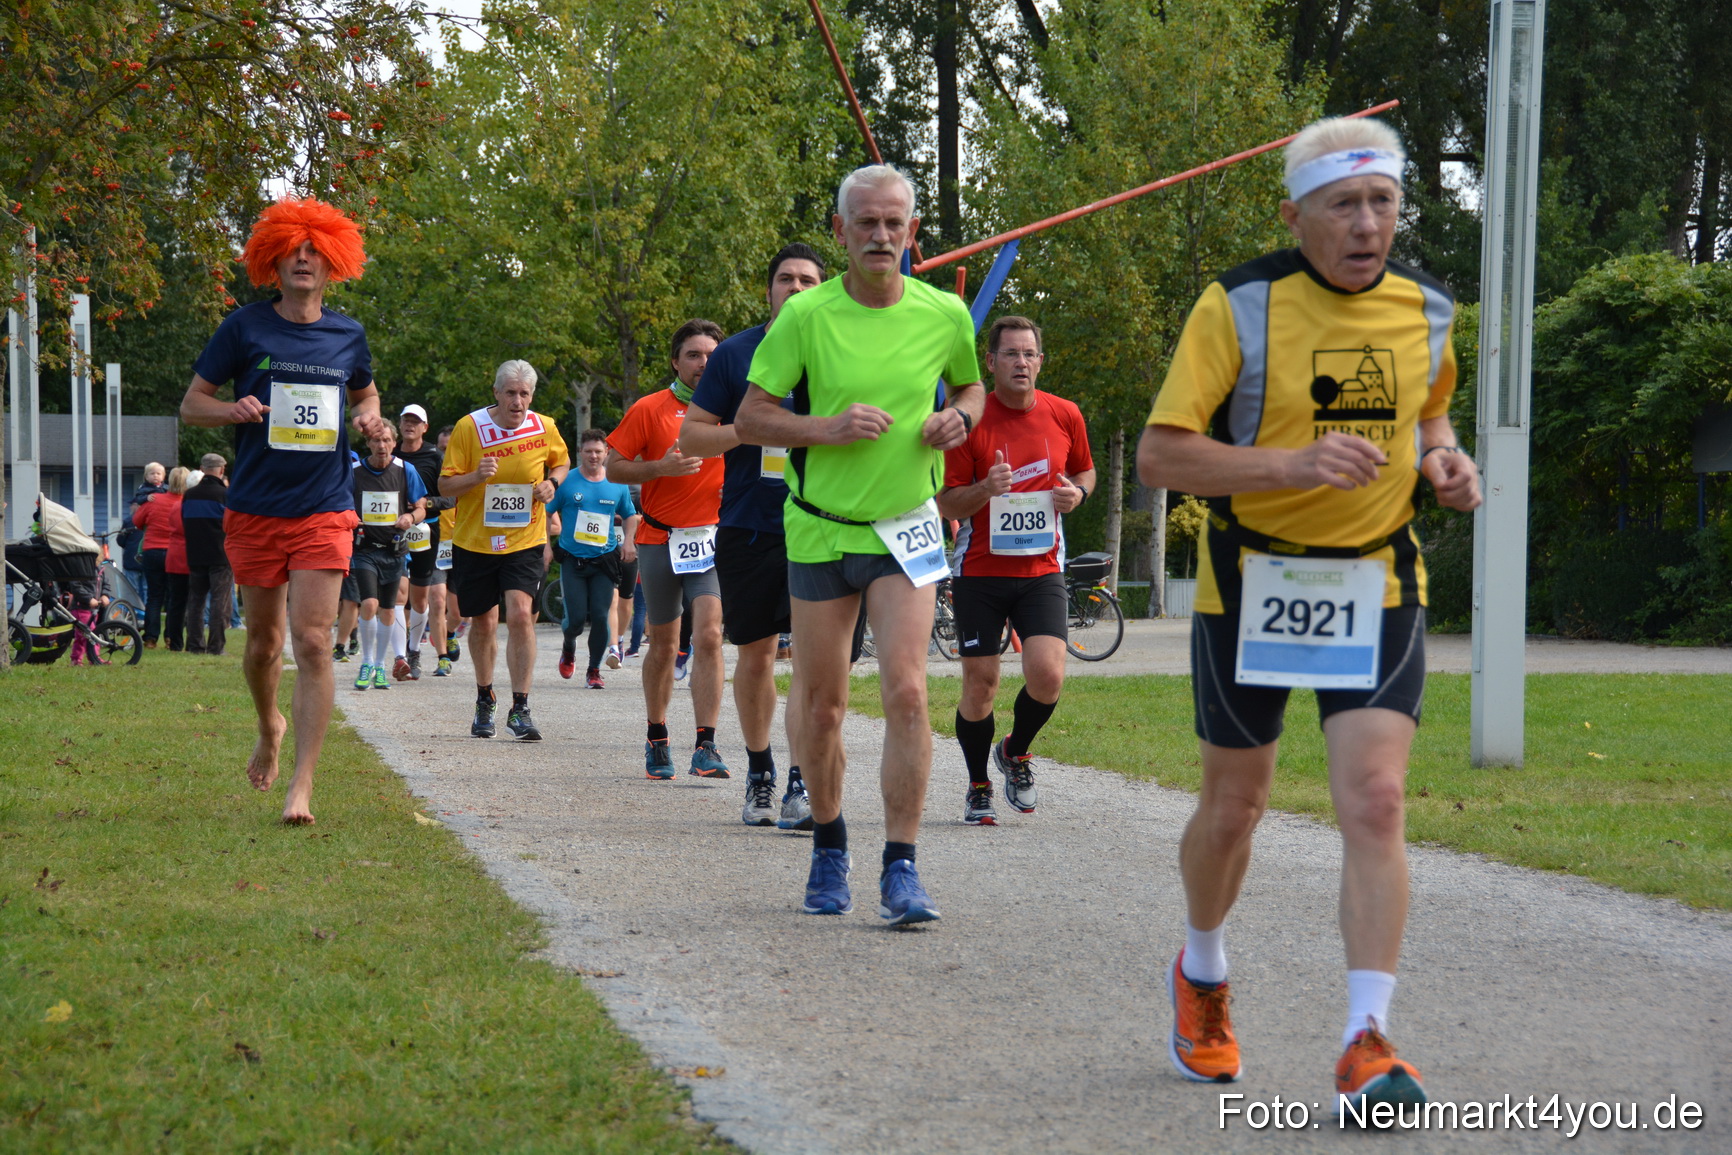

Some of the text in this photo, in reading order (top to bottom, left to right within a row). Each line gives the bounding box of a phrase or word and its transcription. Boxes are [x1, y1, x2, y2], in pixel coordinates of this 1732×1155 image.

[270, 361, 345, 379] GOSSEN METRAWATT
[293, 405, 319, 425] 35
[294, 431, 316, 440] Armin
[483, 439, 547, 458] MAX BÖGL
[1019, 466, 1038, 478] DEHN
[370, 502, 390, 513] 217
[491, 496, 525, 511] 2638
[586, 522, 600, 533] 66
[1000, 511, 1046, 531] 2038
[678, 538, 716, 559] 2911
[1014, 537, 1033, 545] Oliver
[1261, 597, 1355, 638] 2921
